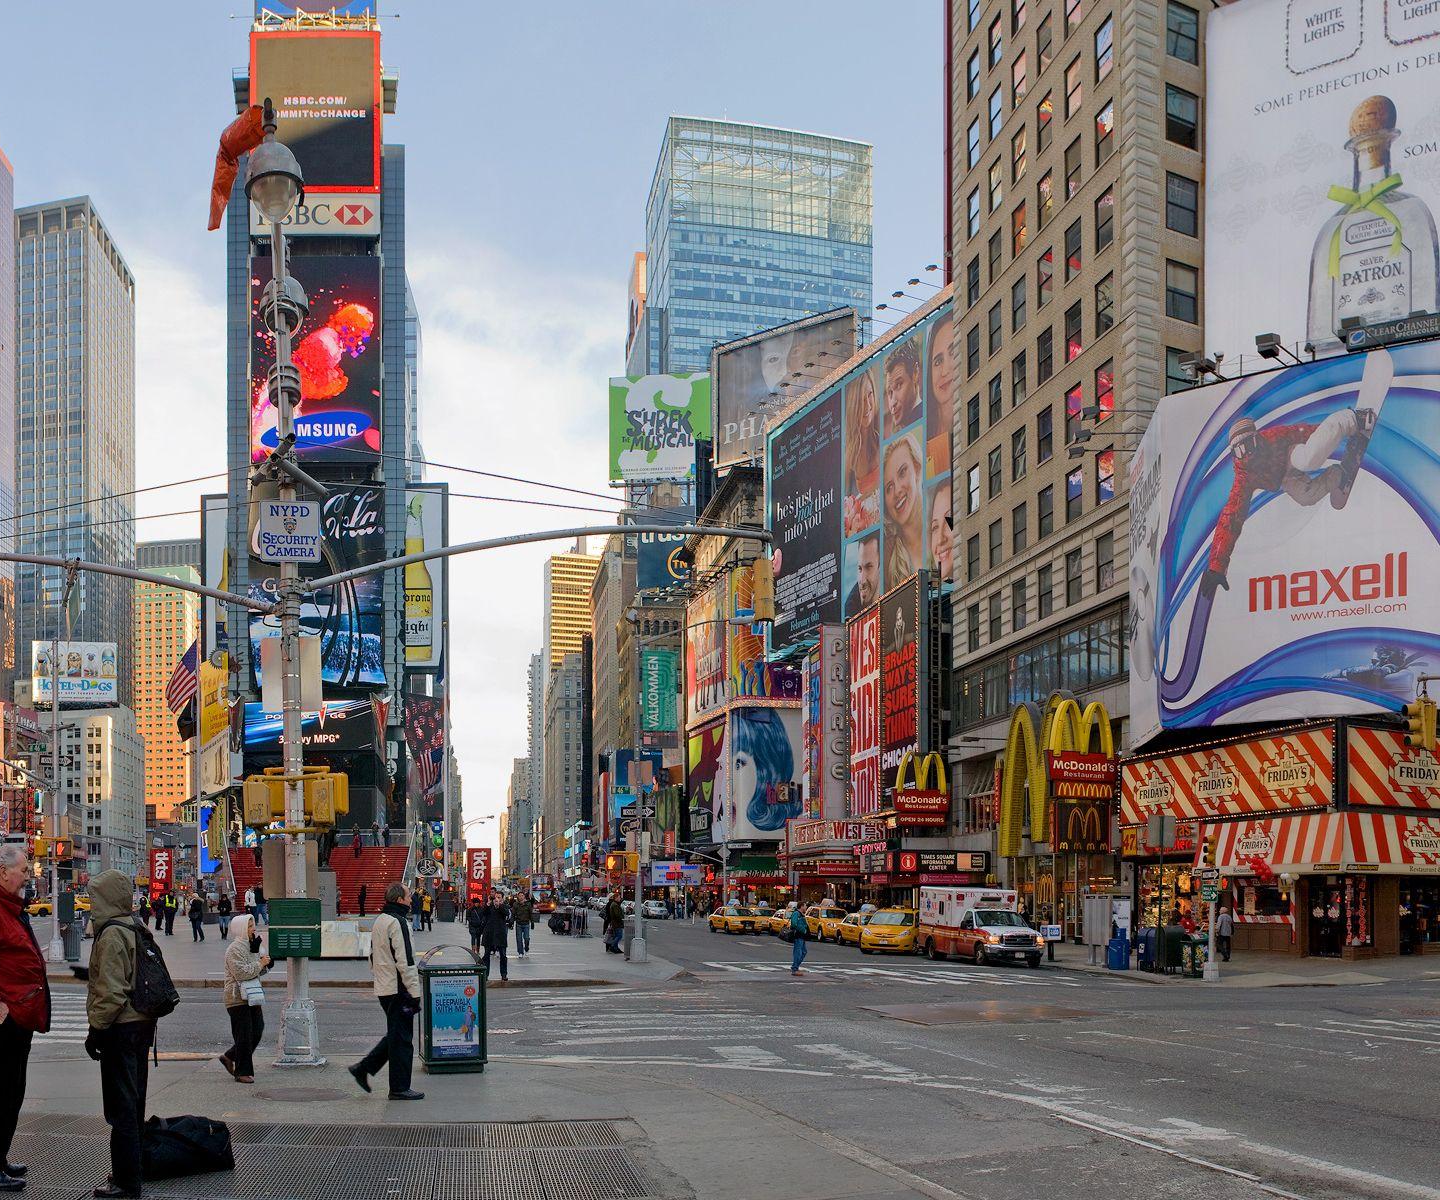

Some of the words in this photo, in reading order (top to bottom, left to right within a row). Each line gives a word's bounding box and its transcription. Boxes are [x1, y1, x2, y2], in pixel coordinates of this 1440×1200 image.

[1305, 7, 1343, 28] WHITE
[1304, 21, 1345, 43] LIGHTS
[1254, 94, 1293, 116] SOME
[1298, 65, 1391, 102] PERFECTION
[1397, 60, 1408, 73] IS
[283, 96, 347, 106] HSBC.COM/
[1358, 220, 1388, 232] TEQUILA
[1359, 255, 1384, 268] SILVER
[1342, 260, 1402, 287] PATRÓN
[624, 408, 694, 437] SHREK
[630, 432, 695, 452] MUSICAL
[814, 487, 834, 512] that
[270, 505, 310, 517] NYPD
[784, 522, 802, 545] into
[803, 509, 822, 540] you
[262, 532, 318, 546] SECURITY
[265, 544, 316, 557] CAMERA
[1248, 551, 1408, 613] maxell
[1290, 601, 1408, 622] www.maxell.com
[790, 615, 811, 633] February
[884, 641, 916, 670] BROAD
[884, 659, 916, 691] WAY'S
[81, 679, 113, 692] DOGS
[649, 655, 659, 728] VÄLKOMMEN
[830, 638, 845, 780] PALACE
[884, 682, 916, 716] SURE
[884, 709, 916, 745] THING
[1053, 759, 1115, 773] McDonald's
[1063, 772, 1105, 780] Restaurant
[1267, 767, 1307, 783] FRIDAY'S
[1139, 785, 1169, 802] FRIDAY'S
[1198, 776, 1233, 792] FRIDAY'S
[897, 795, 947, 805] McDonald's
[1122, 834, 1137, 850] 47
[1241, 837, 1269, 851] FRIDAY'S
[154, 852, 169, 880] tkts
[473, 851, 488, 880] tkts
